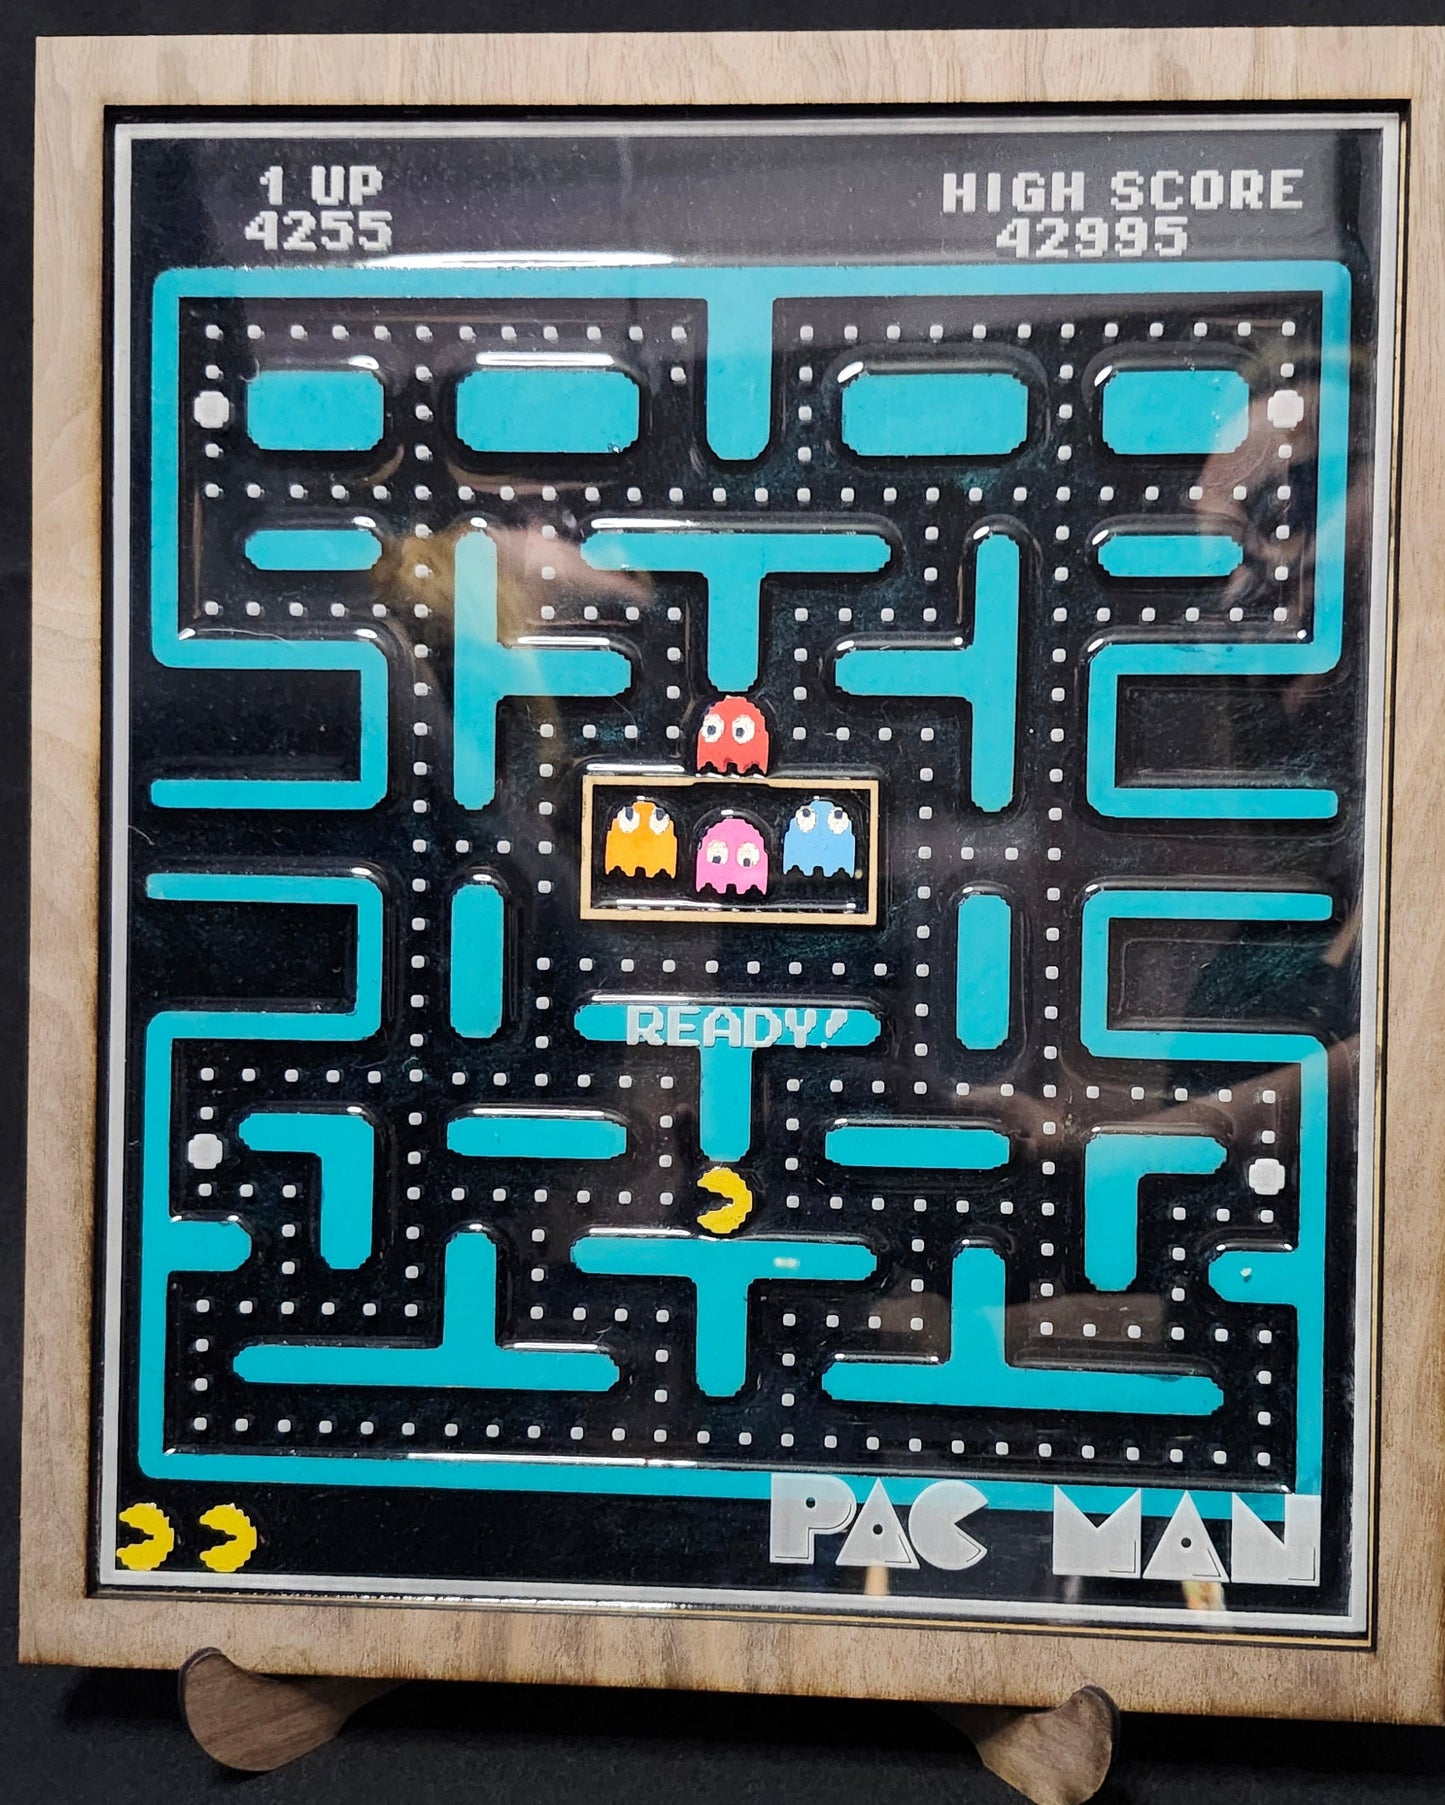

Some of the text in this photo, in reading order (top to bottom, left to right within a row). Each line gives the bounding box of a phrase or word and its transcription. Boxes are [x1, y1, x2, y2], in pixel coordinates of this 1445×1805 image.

[259, 165, 383, 206] 1 UP
[943, 169, 1304, 212] HIGH SCORE
[244, 210, 393, 250] 4255
[996, 216, 1188, 258] 42995
[626, 1005, 848, 1049] READY!
[769, 1472, 1322, 1586] PAC MAN
